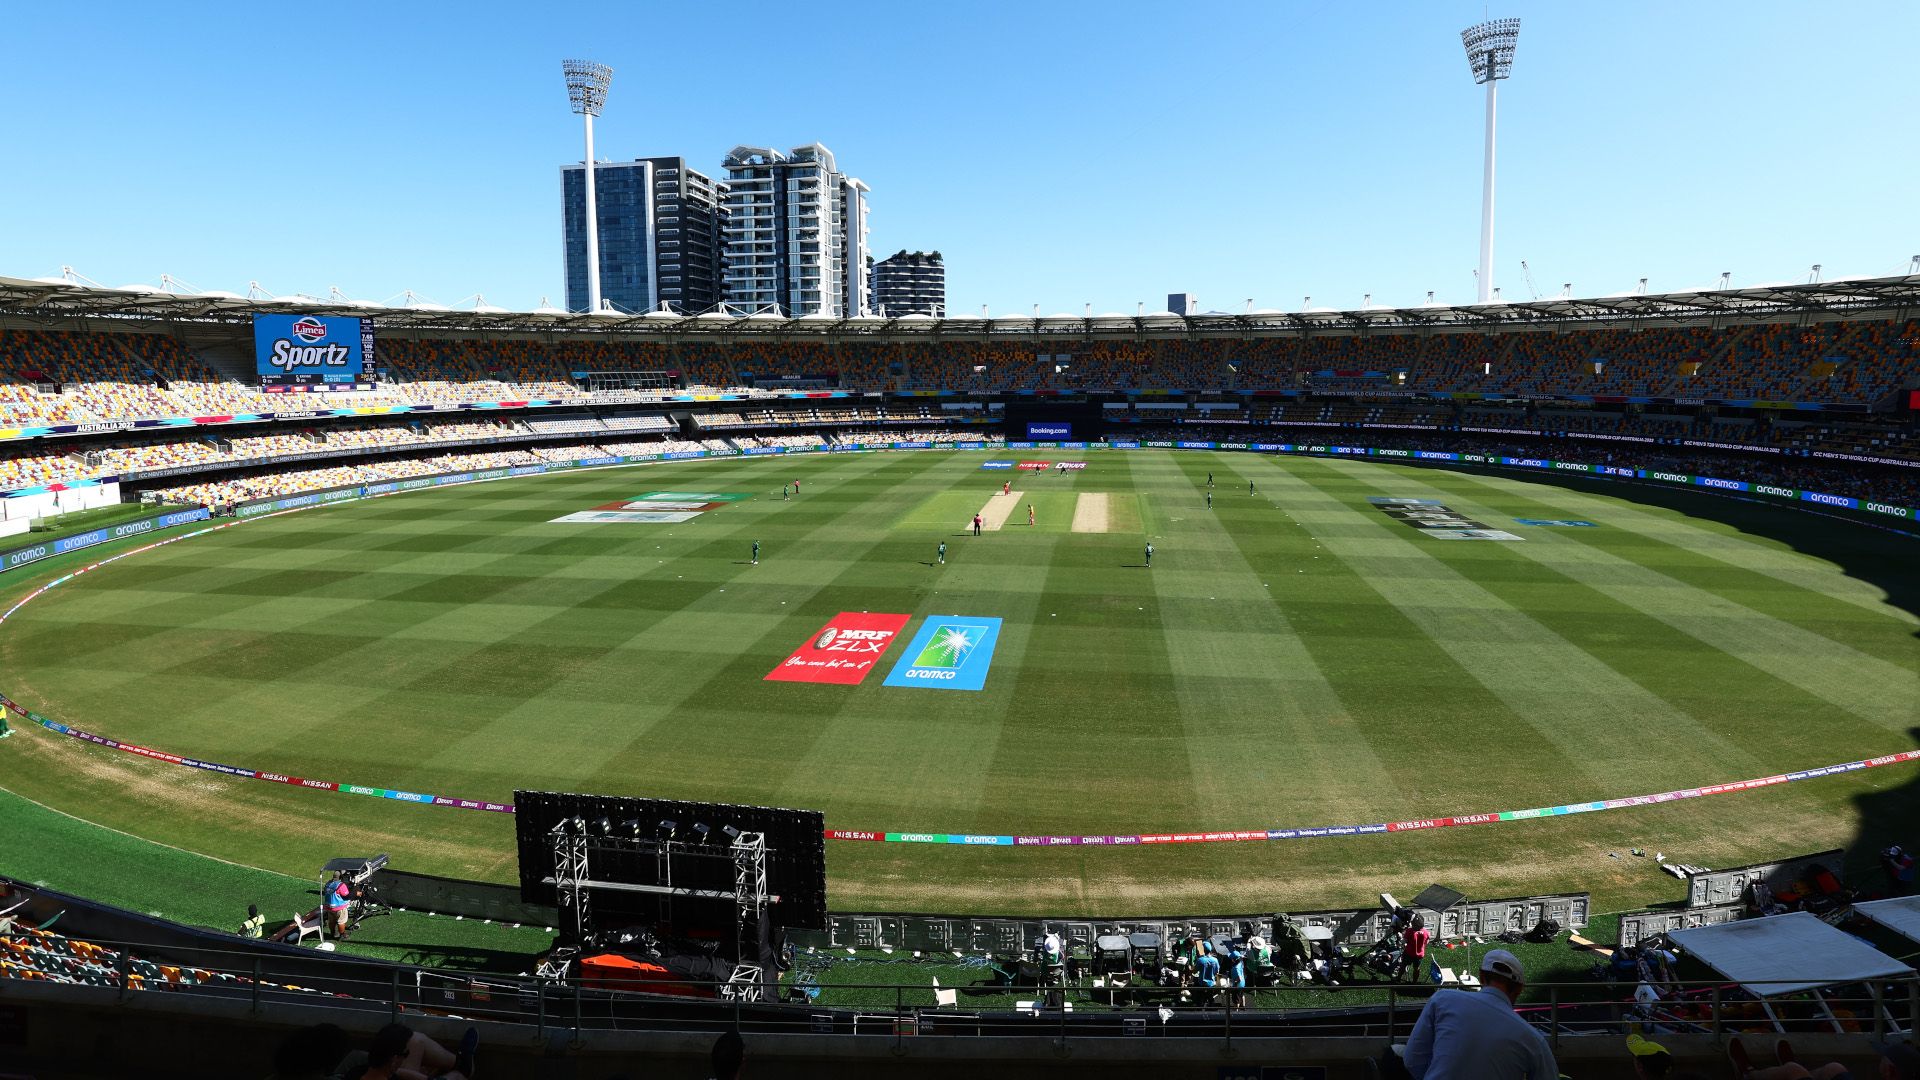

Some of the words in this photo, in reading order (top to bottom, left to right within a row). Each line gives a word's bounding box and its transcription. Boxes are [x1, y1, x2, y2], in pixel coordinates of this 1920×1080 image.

[294, 324, 325, 335] Limca
[271, 340, 348, 371] Sportz
[77, 423, 117, 432] AUSTRALIA
[1030, 427, 1068, 435] Booking.com
[750, 446, 776, 454] aramco
[587, 456, 616, 465] aramco
[629, 453, 657, 461] aramco
[543, 460, 572, 469] aramco
[1556, 462, 1588, 471] aramco
[1879, 458, 1909, 466] AUSTRALIA
[478, 469, 503, 478] aramco
[515, 466, 539, 474] aramco
[442, 474, 467, 483] aramco
[1654, 472, 1687, 482] aramco
[404, 479, 429, 488] aramco
[1705, 478, 1739, 489] aramco
[325, 489, 352, 500] aramco
[1756, 485, 1793, 497] aramco
[284, 496, 312, 507] aramco
[1811, 493, 1848, 506] aramco
[244, 503, 272, 515] aramco
[1867, 502, 1906, 516] aramco
[167, 510, 202, 524] aramco
[116, 520, 151, 536] aramco
[64, 533, 98, 549] aramco
[12, 546, 45, 564] aramco
[837, 630, 894, 640] MRF
[826, 640, 884, 652] ZLX
[785, 656, 806, 667] You
[825, 658, 846, 668] bet
[857, 660, 871, 669] it
[905, 669, 956, 680] aramco
[1871, 756, 1896, 765] NISSAN
[261, 773, 288, 782] NISSAN
[302, 780, 331, 788] NISSAN
[350, 786, 373, 794] aramco
[396, 792, 421, 801] aramco
[1513, 809, 1541, 818] aramco
[1453, 815, 1490, 824] NISSAN
[1397, 821, 1434, 830] NISSAN
[834, 831, 874, 840] NISSAN
[901, 834, 933, 842] aramco
[964, 835, 997, 844] aramco
